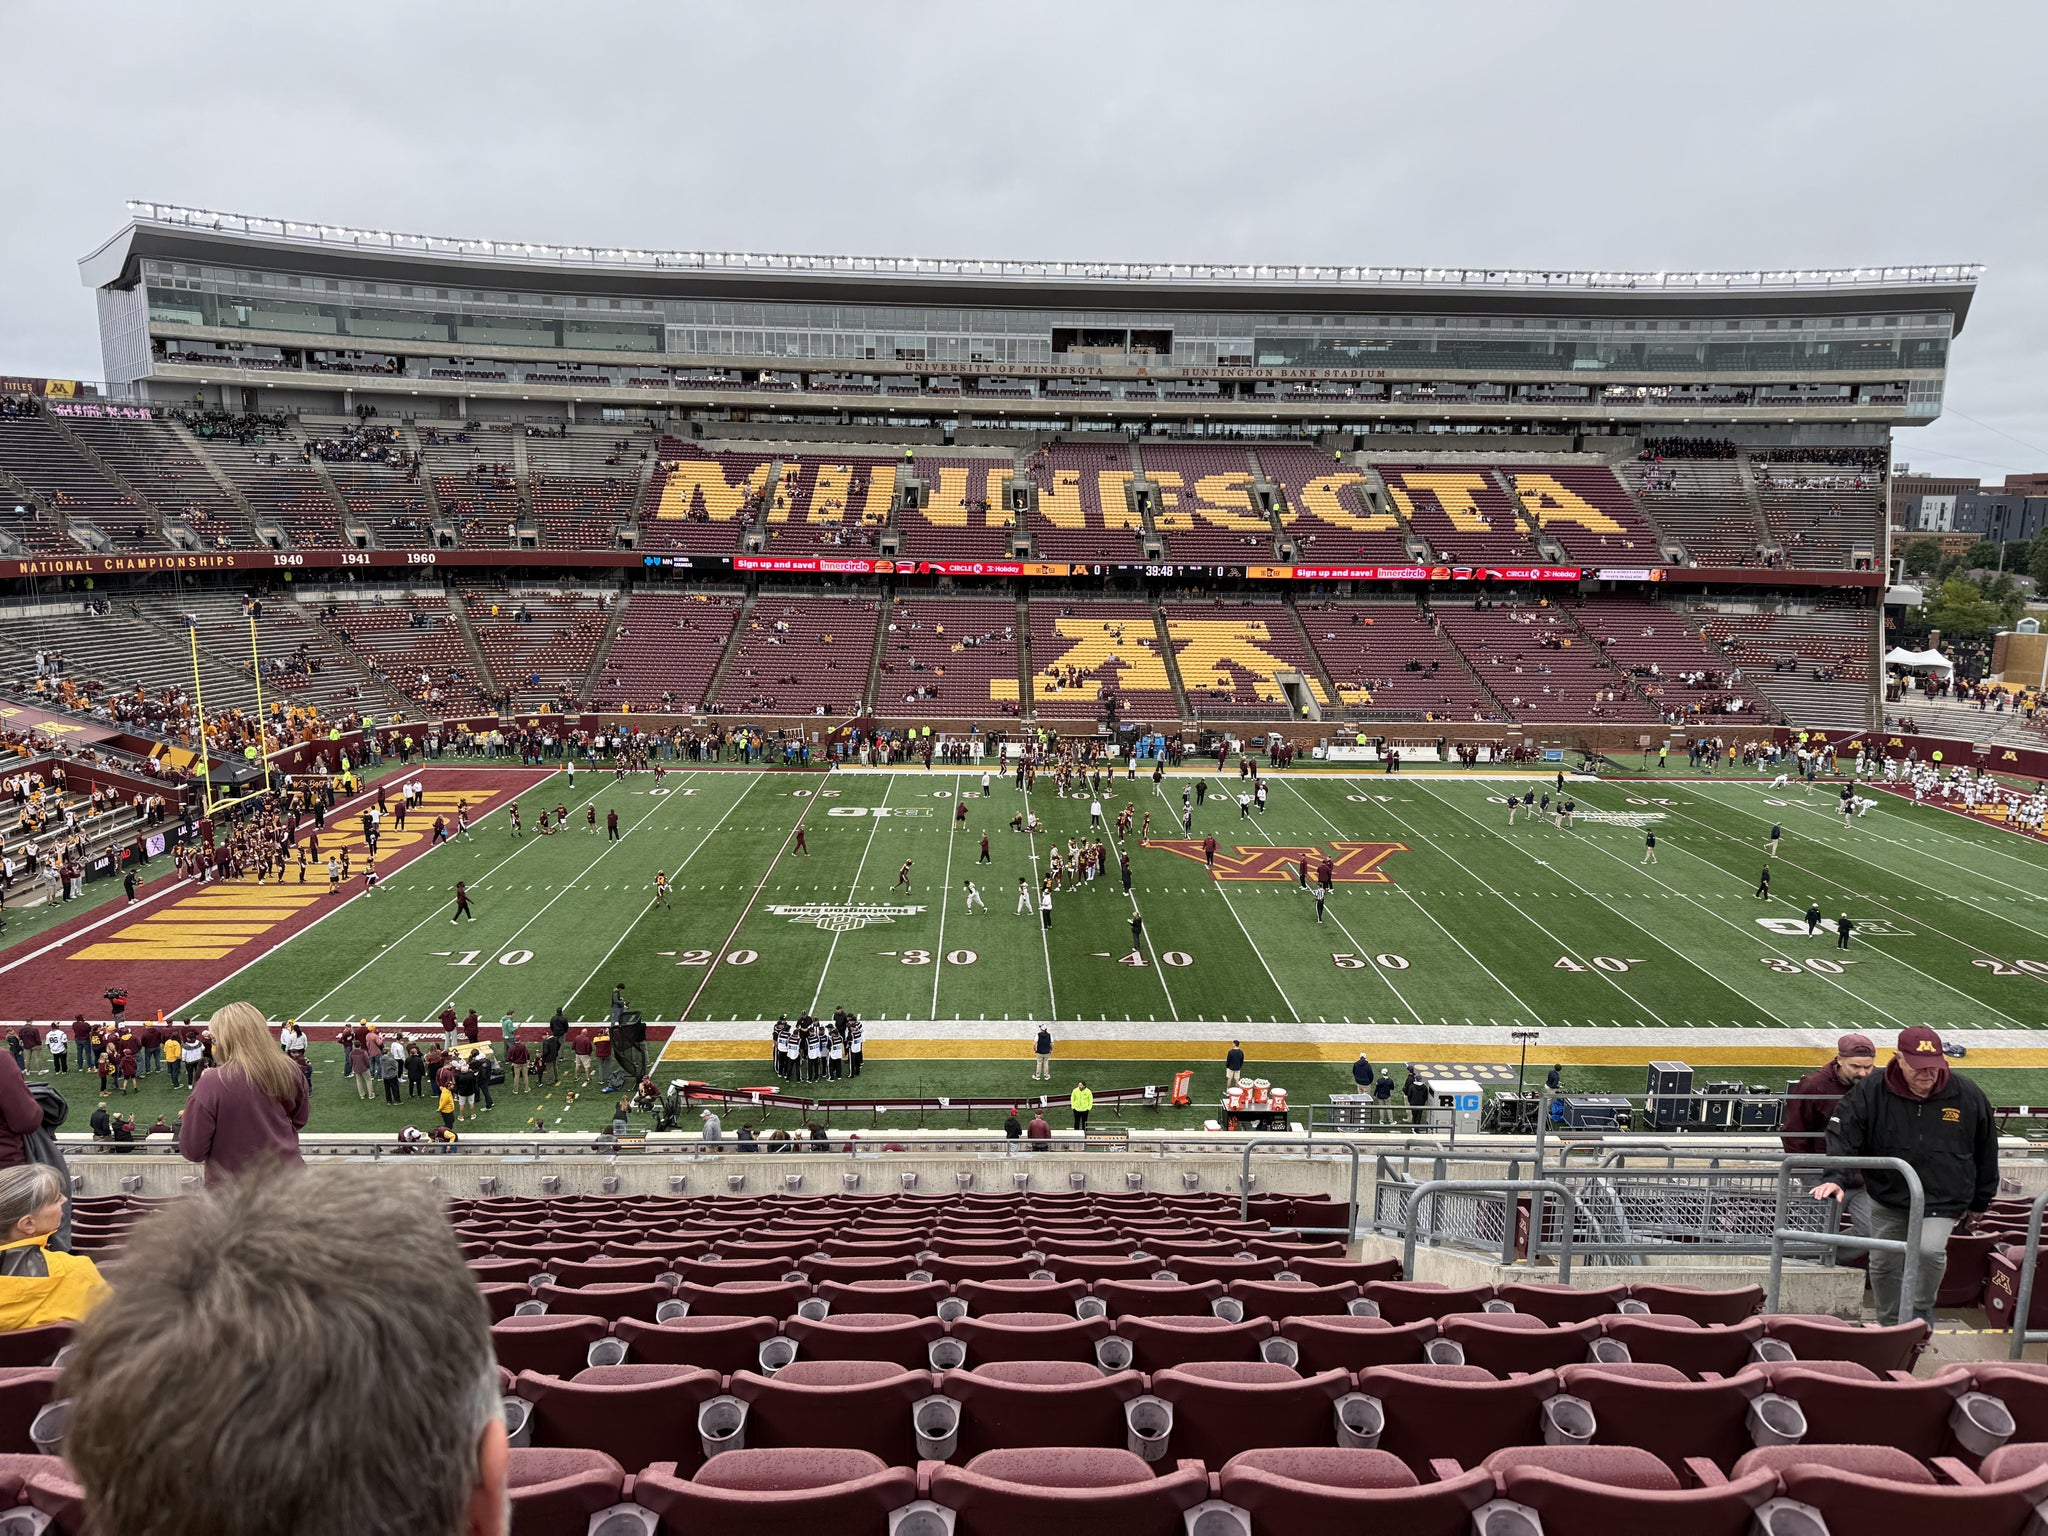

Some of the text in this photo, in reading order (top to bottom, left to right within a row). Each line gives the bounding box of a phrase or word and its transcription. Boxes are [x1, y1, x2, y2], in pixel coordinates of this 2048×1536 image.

[905, 362, 1104, 375] UNIVERSITY OF MINNESOTA
[1182, 368, 1386, 378] HUNTINGTON BANK STADIUM
[4, 382, 33, 392] TITLES
[273, 554, 303, 565] 1940
[341, 553, 370, 564] 1941
[407, 553, 436, 563] 1960
[20, 556, 235, 574] NATIONAL CHAMPIONSHIPS
[738, 559, 759, 568] Sign
[774, 561, 790, 569] and
[792, 561, 816, 569] save!
[1094, 565, 1100, 575] 0
[1145, 566, 1173, 576] 39:48
[1217, 566, 1224, 577] 0
[1297, 569, 1316, 578] Sign
[1332, 569, 1348, 577] and
[1350, 569, 1373, 577] save!
[1812, 732, 1827, 742] M
[1888, 737, 1904, 748] M
[2002, 750, 2018, 762] M
[649, 788, 701, 796] 10
[792, 790, 842, 798] 20
[1346, 795, 1394, 803] 40
[446, 949, 535, 967] 10
[674, 949, 759, 967] 20
[900, 949, 979, 967] 30
[1117, 949, 1195, 967] 40
[1331, 953, 1411, 970] 50
[1552, 956, 1631, 972] 40
[1760, 957, 1846, 974] 30
[1916, 1040, 1936, 1052] M
[1991, 1270, 2012, 1295] M
